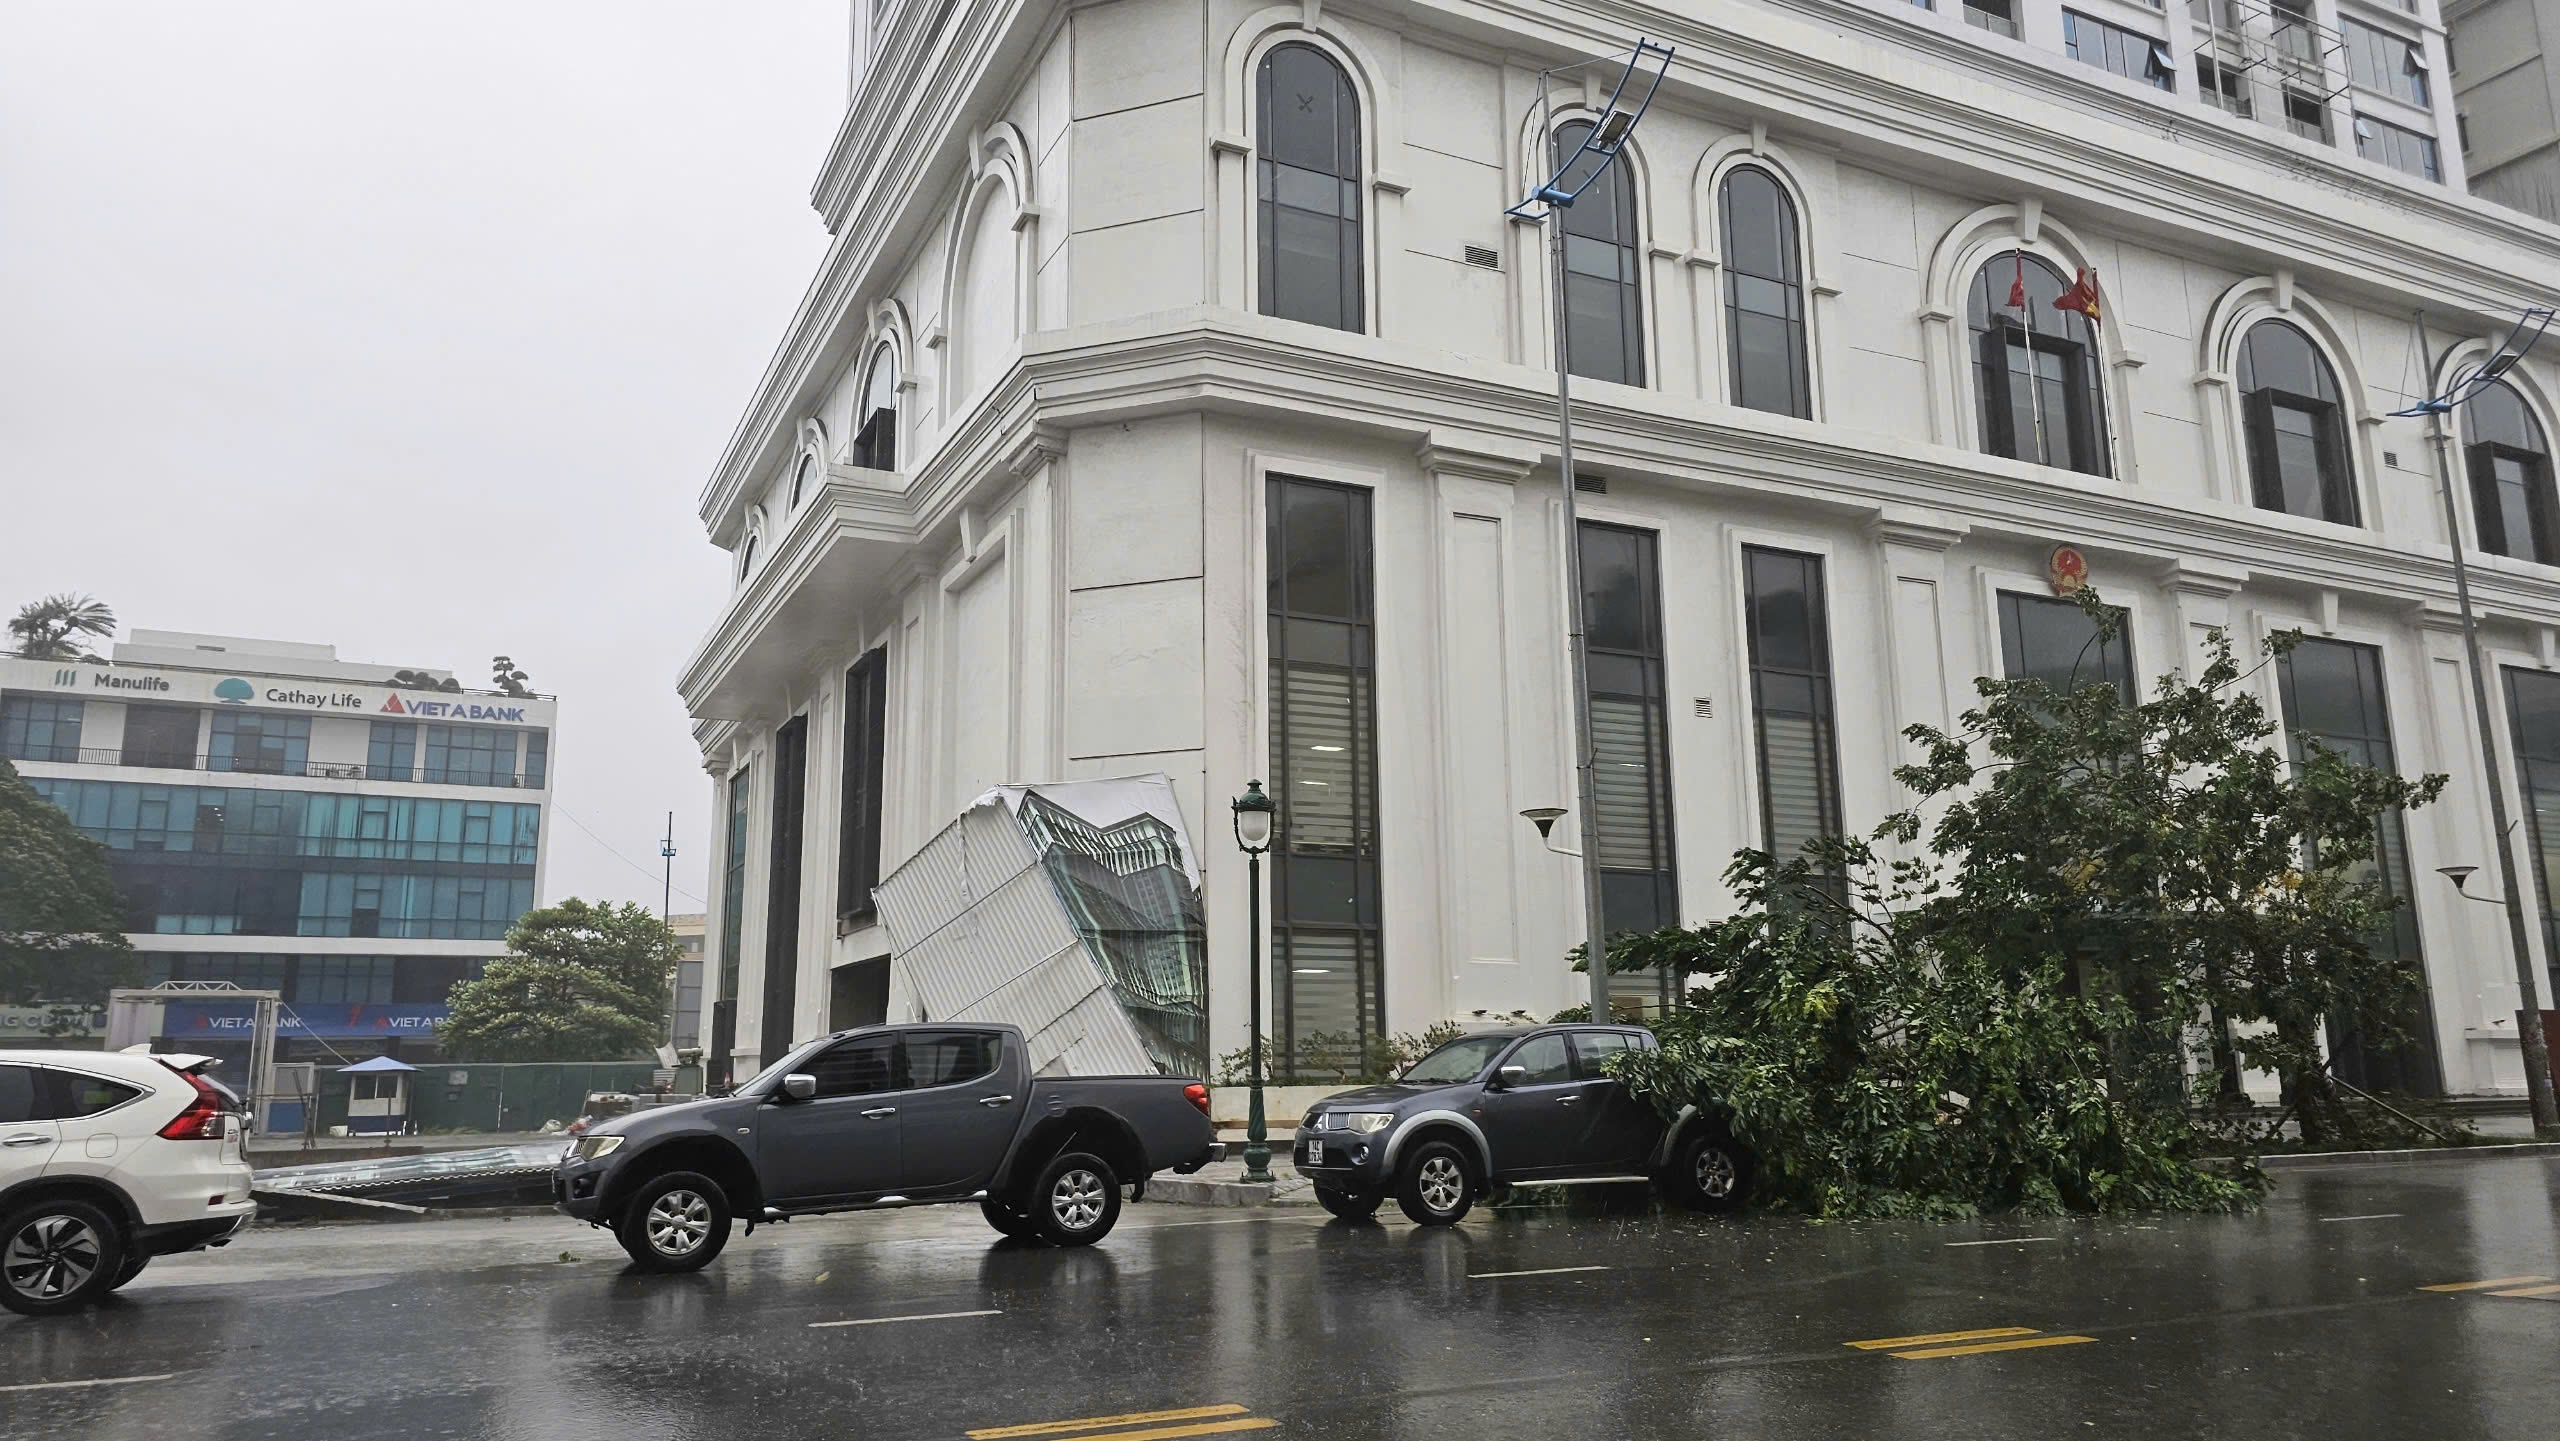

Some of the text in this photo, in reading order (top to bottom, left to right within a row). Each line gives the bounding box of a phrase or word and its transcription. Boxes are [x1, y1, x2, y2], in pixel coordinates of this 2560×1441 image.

[94, 672, 170, 691] Manulife
[266, 688, 362, 707] Cathay Life
